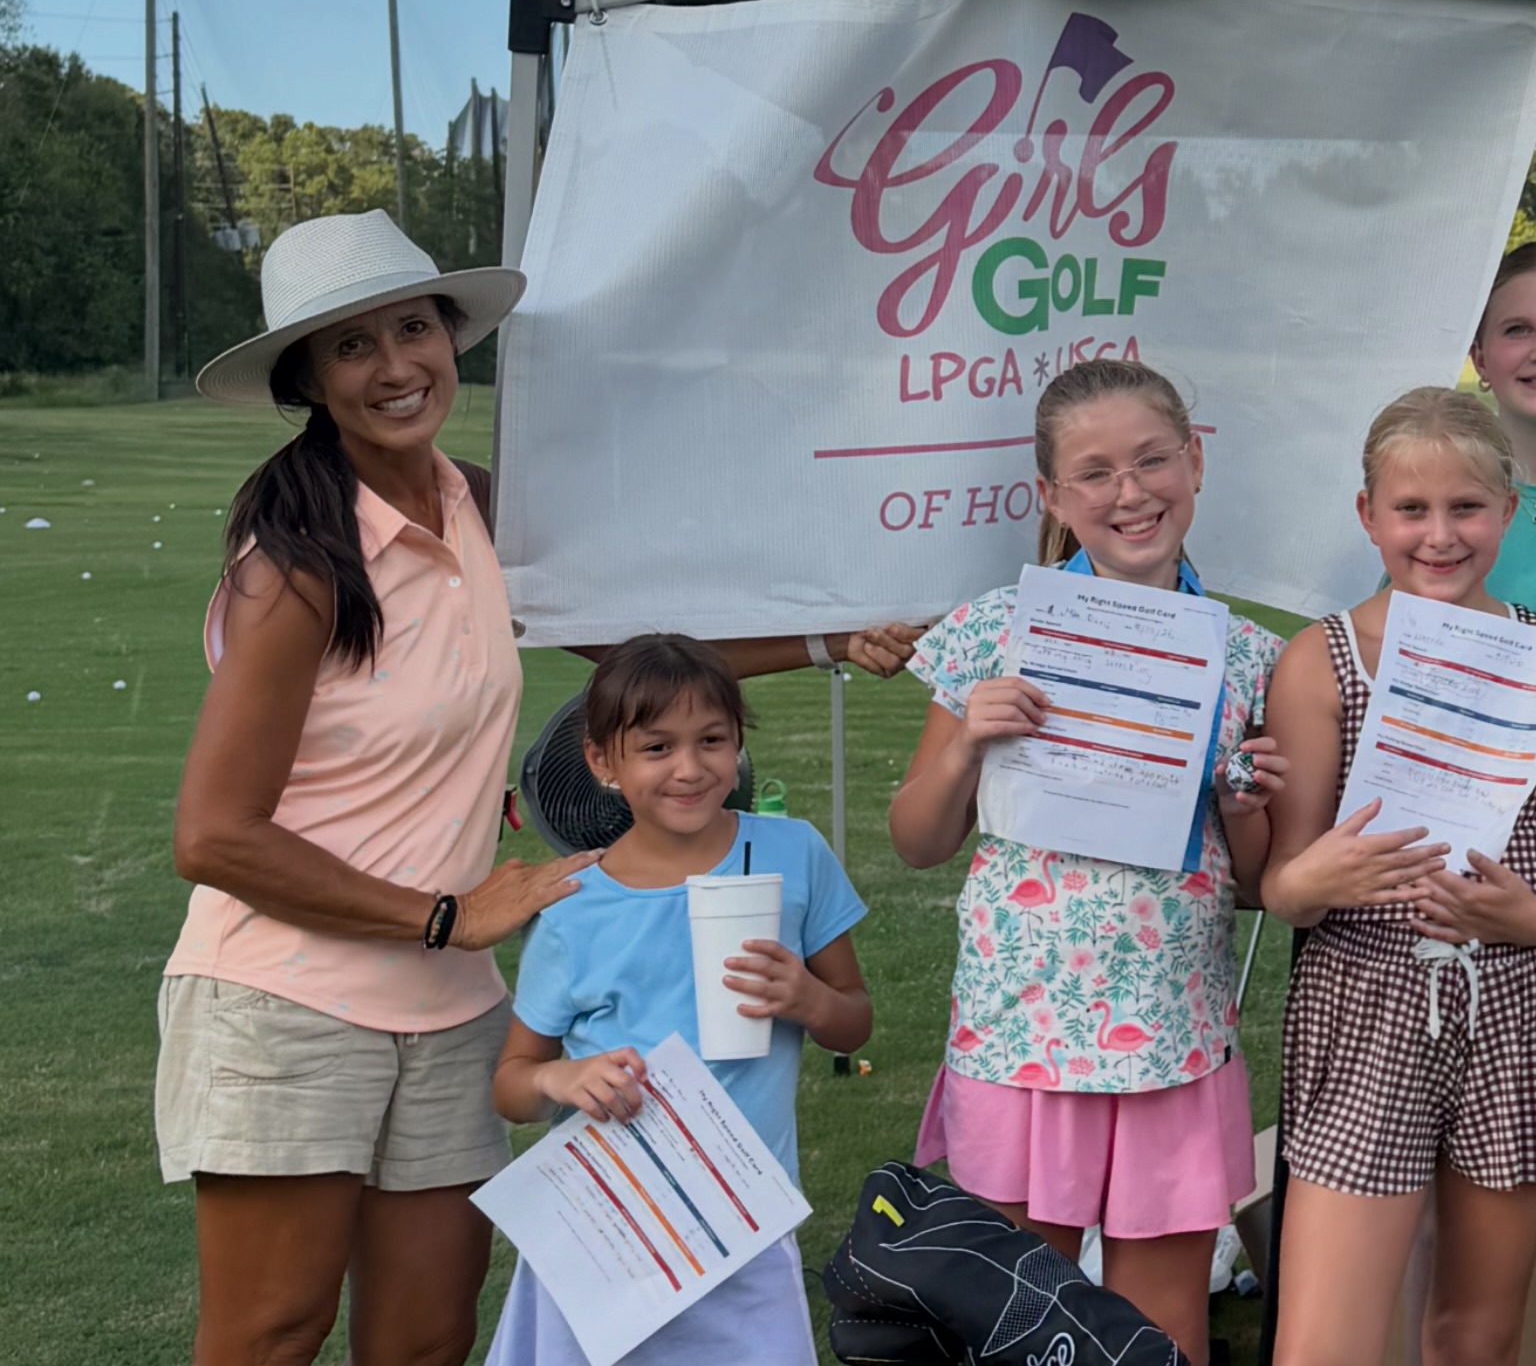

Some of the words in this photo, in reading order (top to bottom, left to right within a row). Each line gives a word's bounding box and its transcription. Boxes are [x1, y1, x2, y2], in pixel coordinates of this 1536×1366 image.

[814, 58, 1178, 339] Girls
[899, 347, 1024, 403] LPGA
[879, 489, 952, 532] OF
[961, 481, 1045, 527] HO
[872, 1195, 905, 1227] 1
